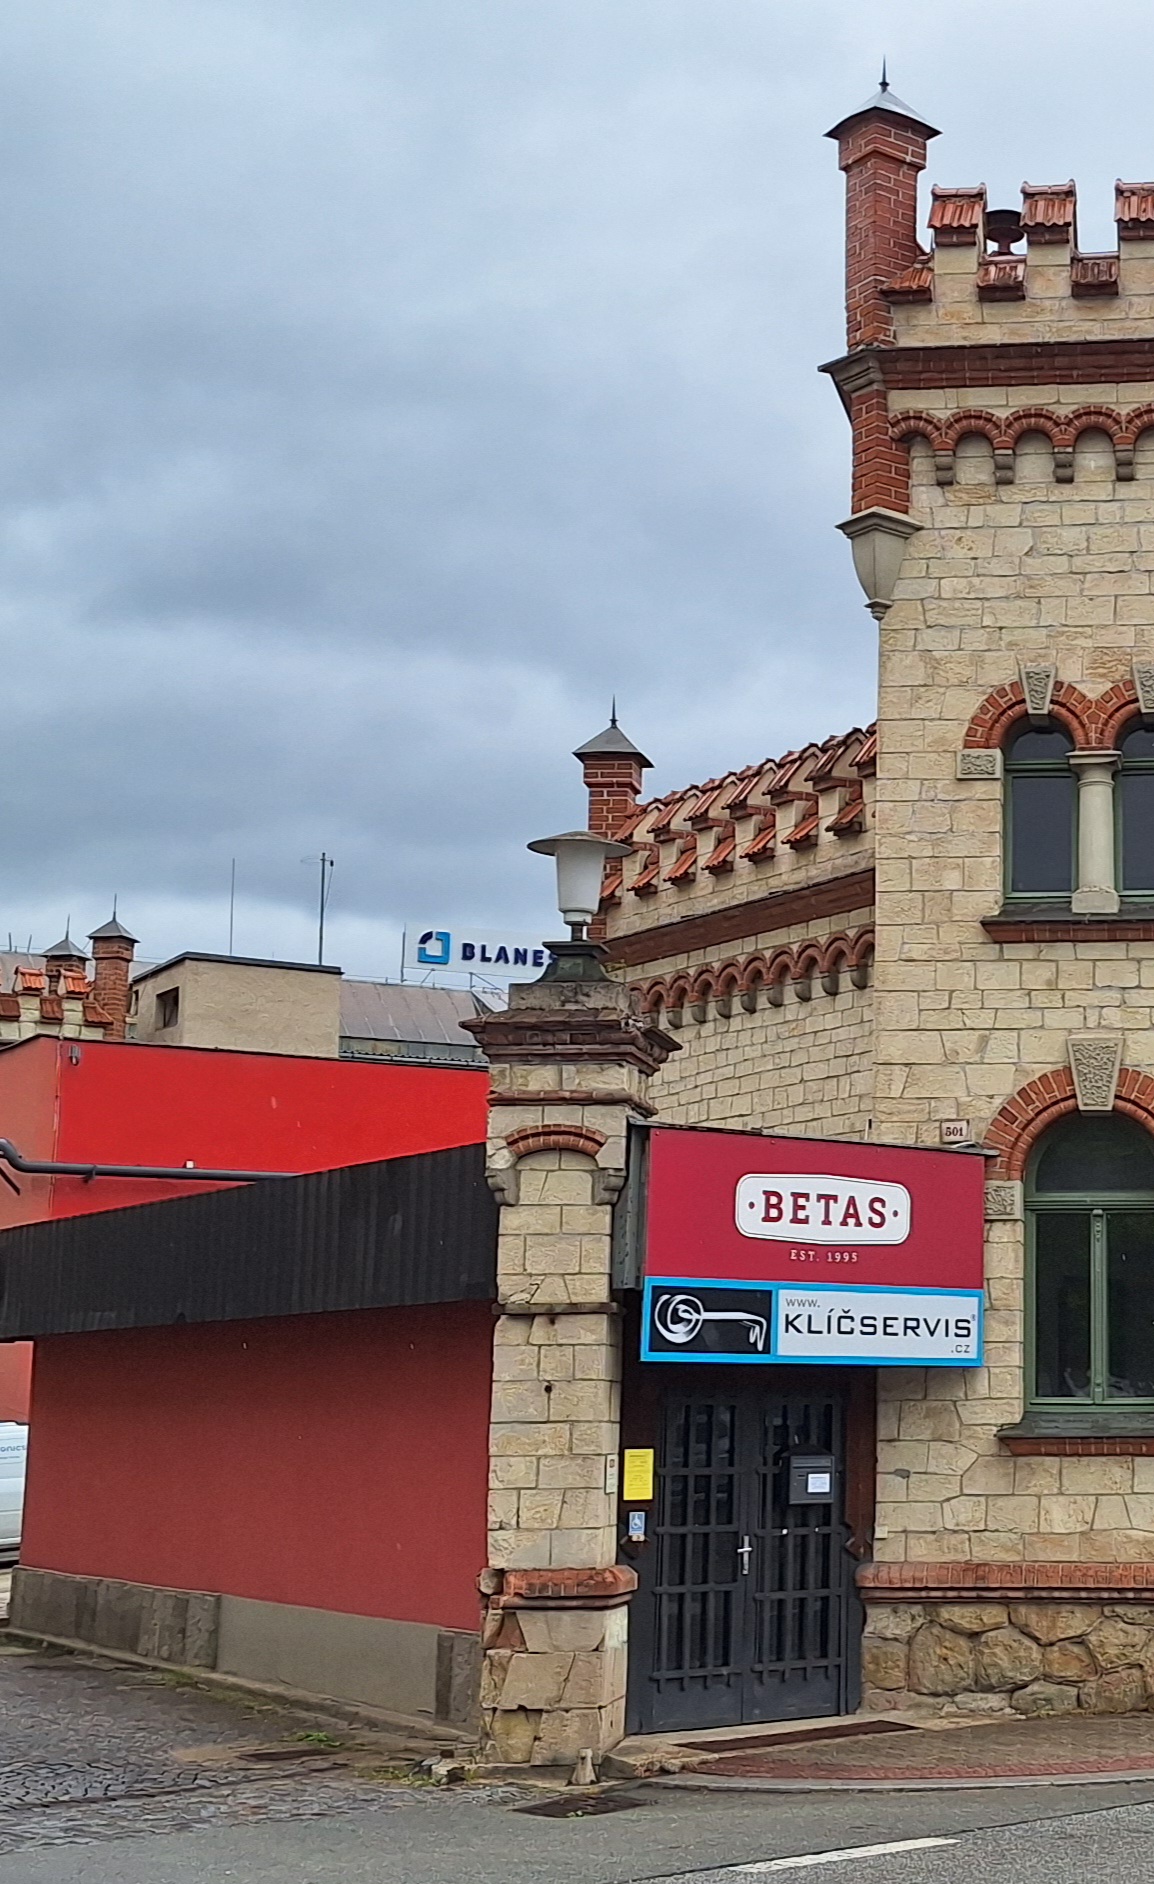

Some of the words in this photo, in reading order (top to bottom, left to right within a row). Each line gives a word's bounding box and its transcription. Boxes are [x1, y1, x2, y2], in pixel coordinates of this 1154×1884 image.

[945, 1126, 964, 1137] 501
[761, 1189, 887, 1229] BETAS
[790, 1249, 820, 1262] EST.
[827, 1251, 859, 1263] 1995
